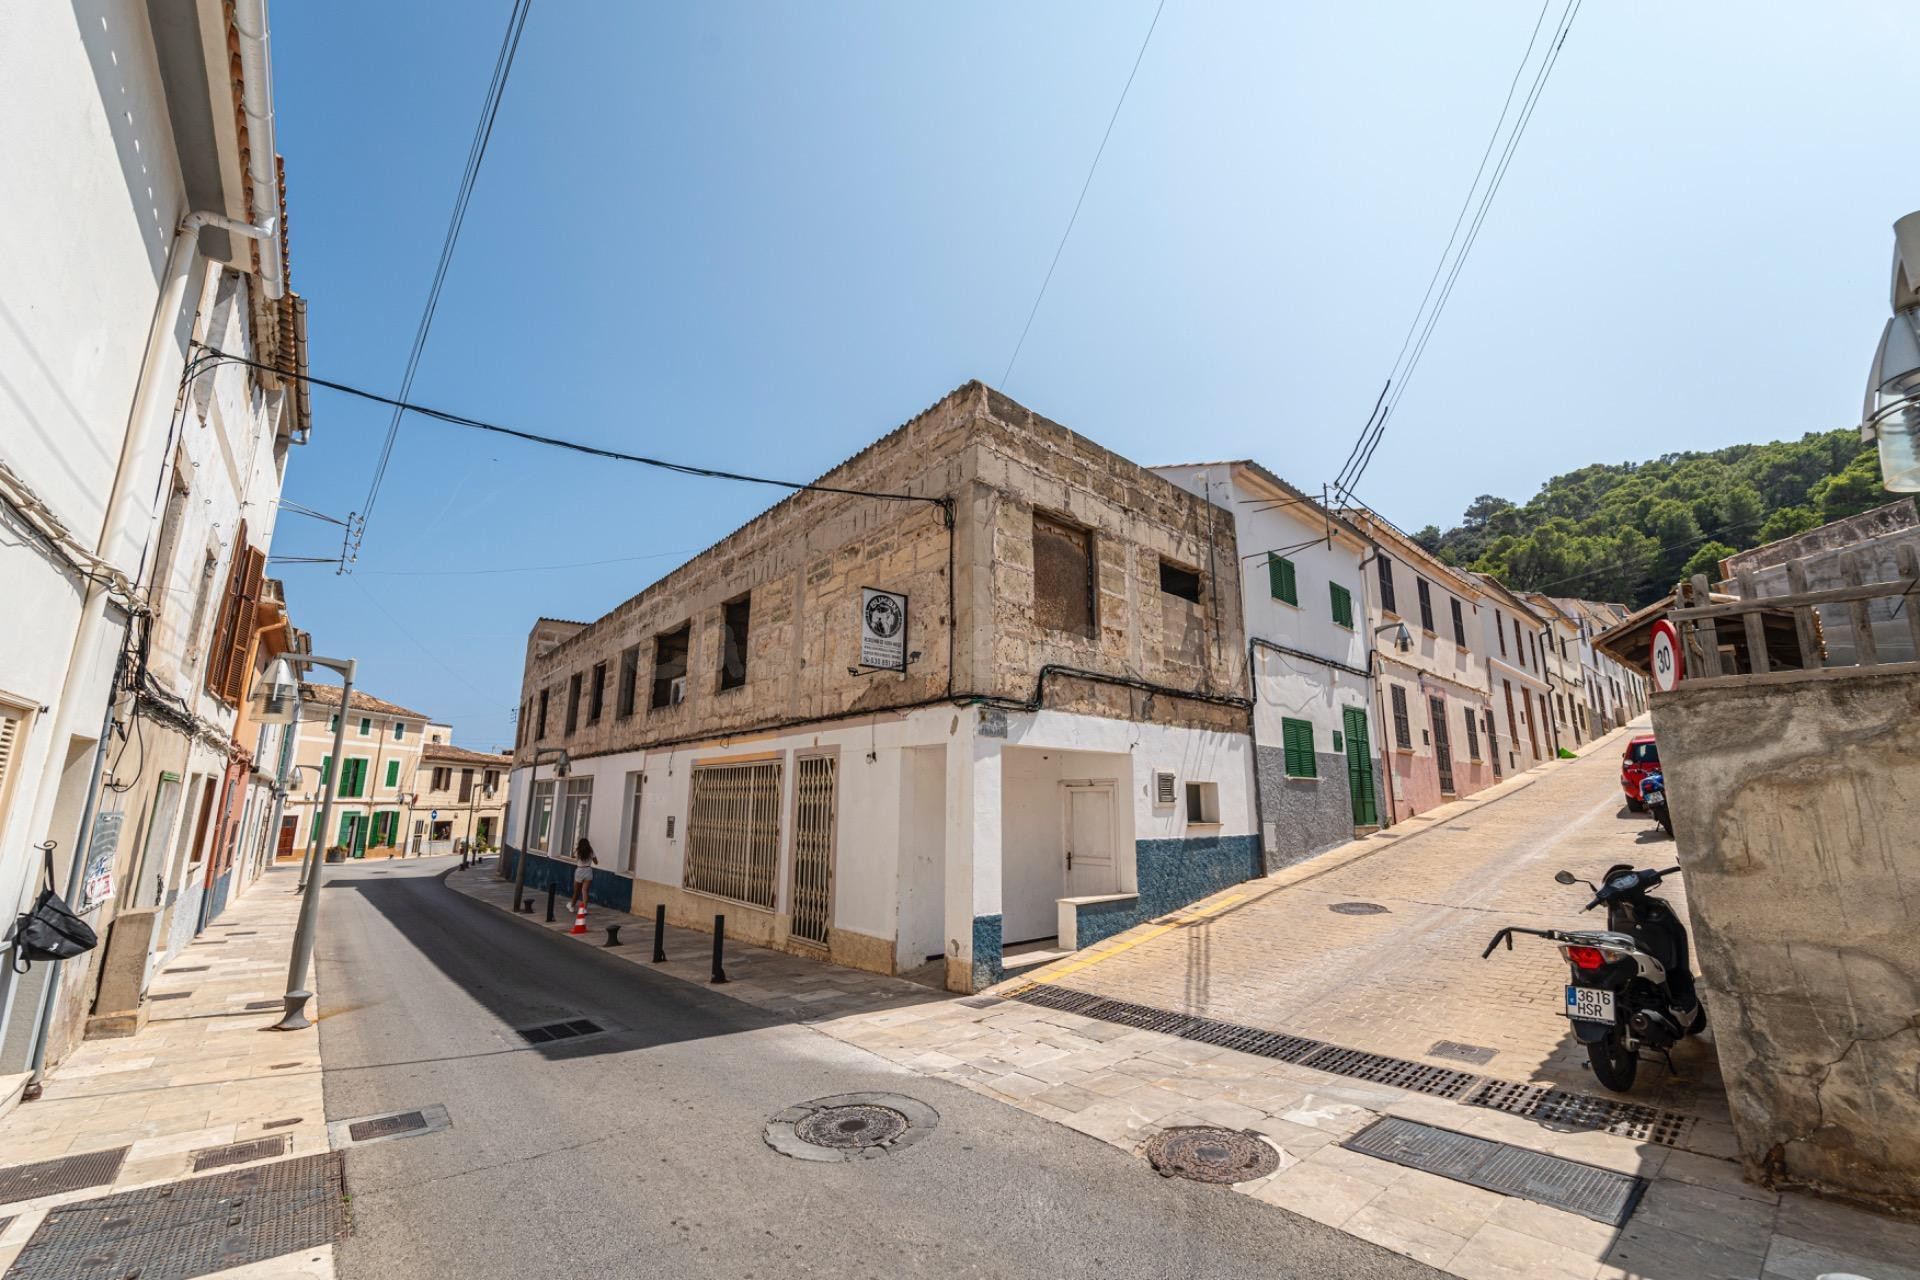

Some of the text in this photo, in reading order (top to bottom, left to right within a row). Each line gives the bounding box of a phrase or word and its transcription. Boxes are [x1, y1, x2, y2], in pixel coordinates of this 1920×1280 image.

[1657, 645, 1671, 674] 30
[1577, 989, 1611, 1005] 3616
[1577, 1002, 1602, 1017] HSR
